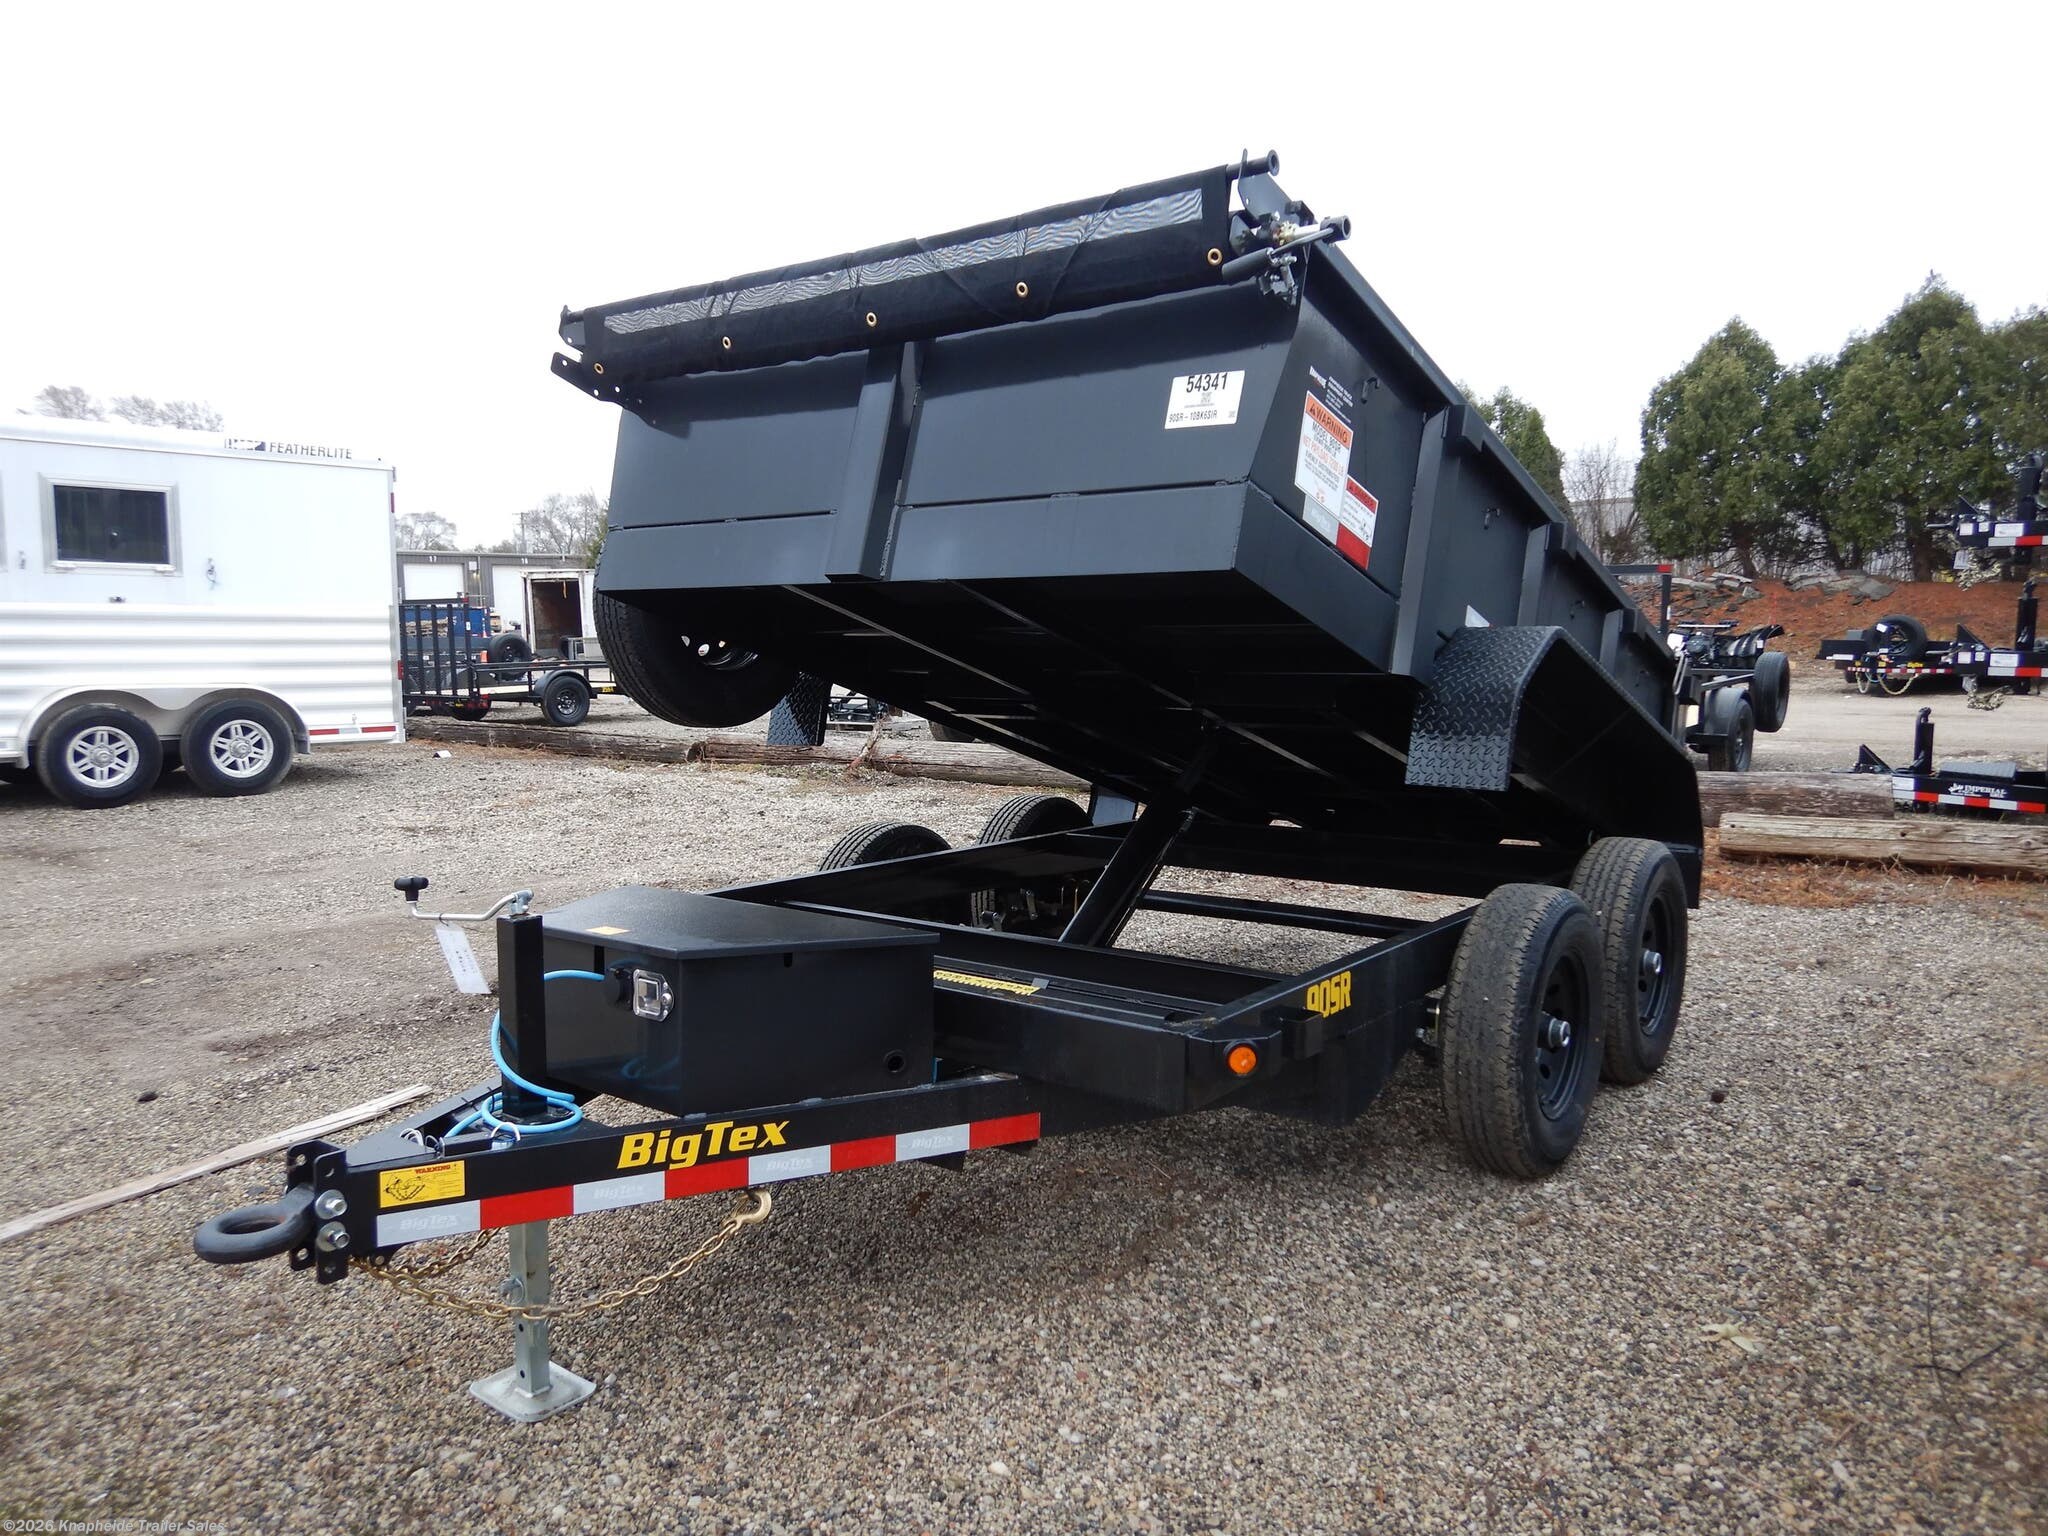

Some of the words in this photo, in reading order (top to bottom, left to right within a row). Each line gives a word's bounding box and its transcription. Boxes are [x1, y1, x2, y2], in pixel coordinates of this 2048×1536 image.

[1186, 372, 1228, 393] 54341
[1316, 406, 1348, 443] WARNING
[269, 441, 353, 460] FEATHERLITE
[1964, 784, 2007, 795] IMPERIAL
[1306, 970, 1351, 1018] 90SR
[616, 1120, 790, 1171] BigTex
[414, 1164, 451, 1175] WARNING
